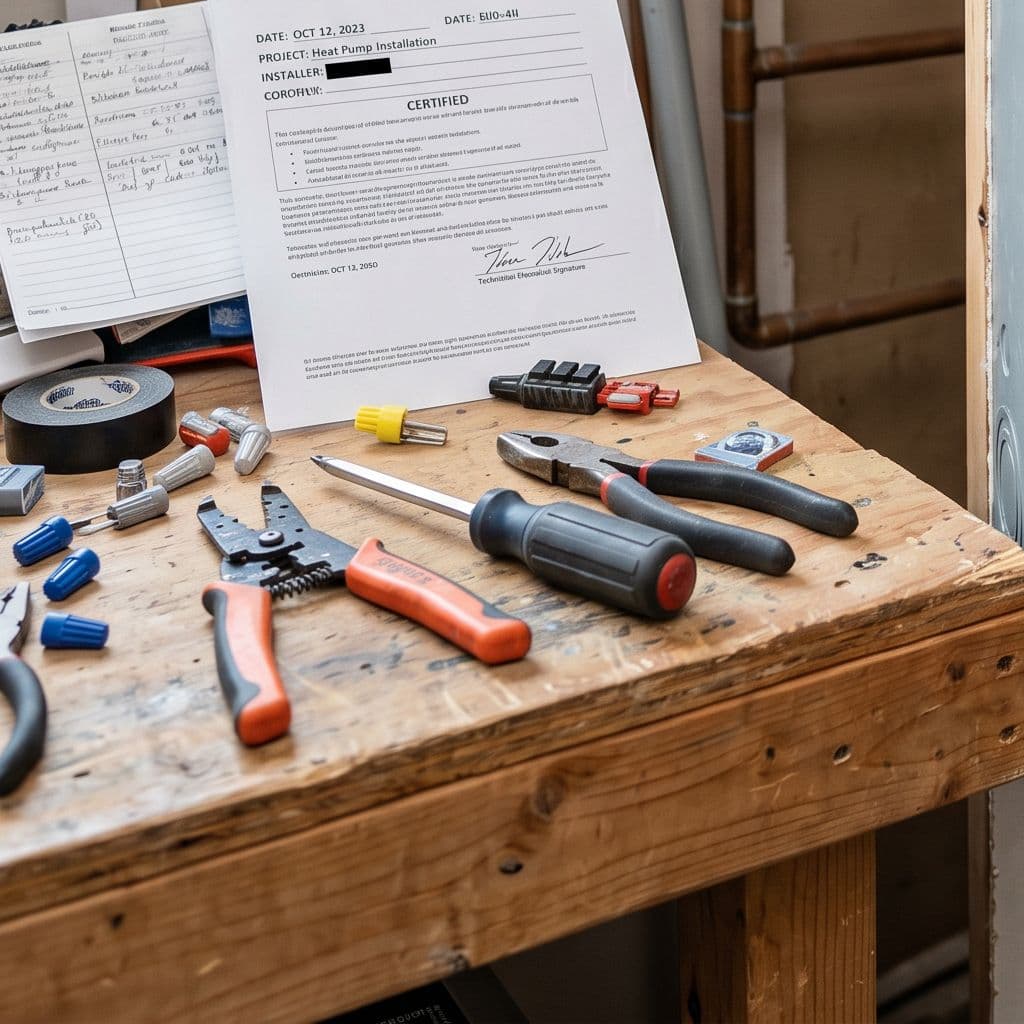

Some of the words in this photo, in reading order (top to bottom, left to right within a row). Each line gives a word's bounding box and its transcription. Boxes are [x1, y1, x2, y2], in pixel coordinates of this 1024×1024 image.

[256, 32, 288, 44] DATE:
[293, 28, 315, 39] OCT
[320, 26, 336, 36] 12,
[339, 23, 365, 35] 2023
[444, 14, 475, 25] DATE:
[259, 50, 309, 63] PROJECT:
[312, 47, 338, 58] Heat
[342, 44, 373, 55] Pump
[376, 37, 437, 52] Installation
[261, 67, 324, 83] INSTALLER:
[407, 94, 469, 111] CERTIFIED
[330, 265, 346, 274] OCT
